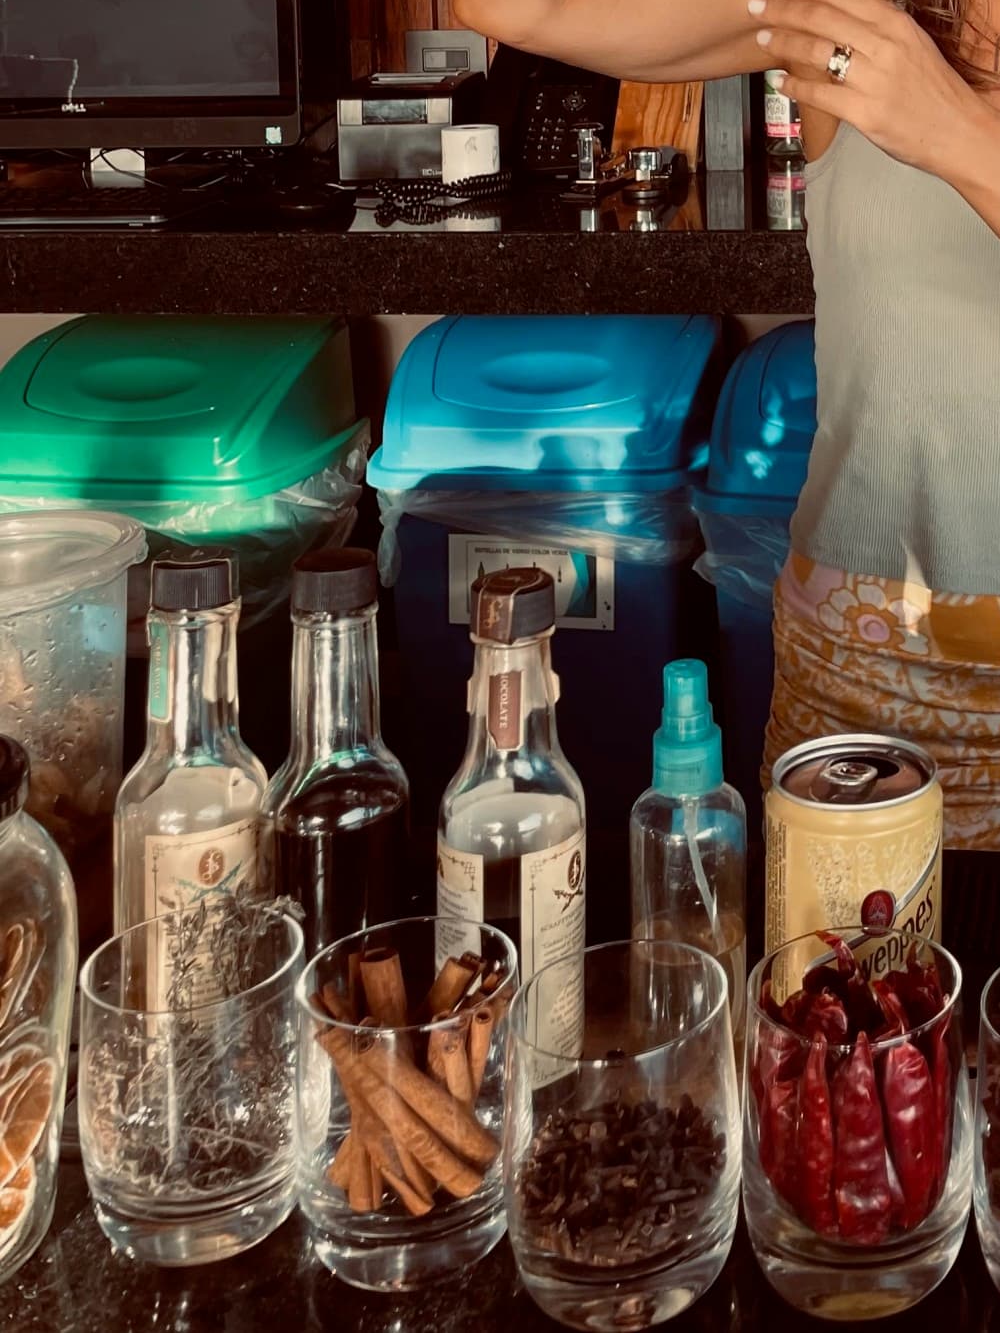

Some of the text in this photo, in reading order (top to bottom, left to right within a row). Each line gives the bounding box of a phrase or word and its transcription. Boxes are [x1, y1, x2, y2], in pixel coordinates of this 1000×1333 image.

[474, 546, 502, 554] BOTELLAS
[531, 548, 550, 556] COLOR
[861, 884, 935, 983] weppes
